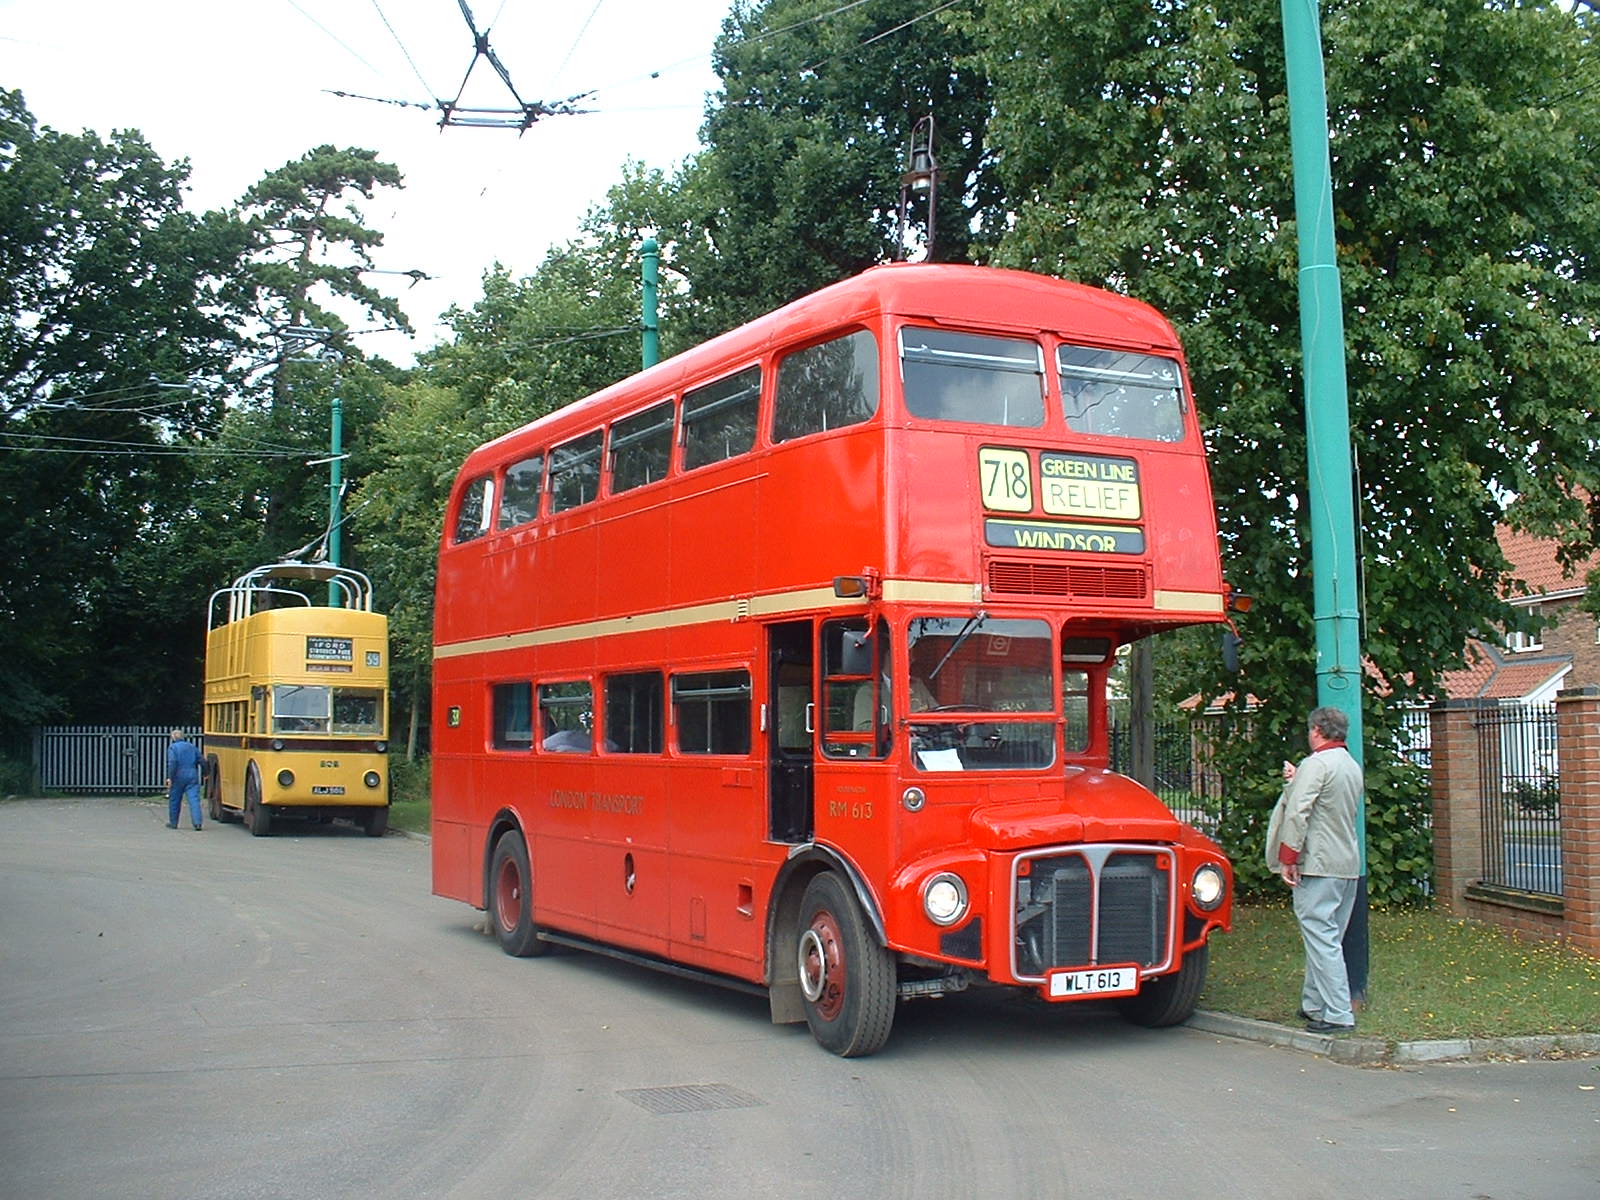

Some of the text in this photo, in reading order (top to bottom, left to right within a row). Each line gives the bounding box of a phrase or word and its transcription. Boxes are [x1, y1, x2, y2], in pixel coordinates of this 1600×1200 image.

[985, 459, 1028, 499] 718
[1041, 458, 1135, 482] GREEN LINE
[1051, 483, 1129, 511] RELIEF
[1014, 529, 1116, 552] WINDSOR
[550, 789, 644, 815] LONDON TRANSPORT
[830, 800, 873, 820] RM 613
[1066, 972, 1121, 991] WLT 613
